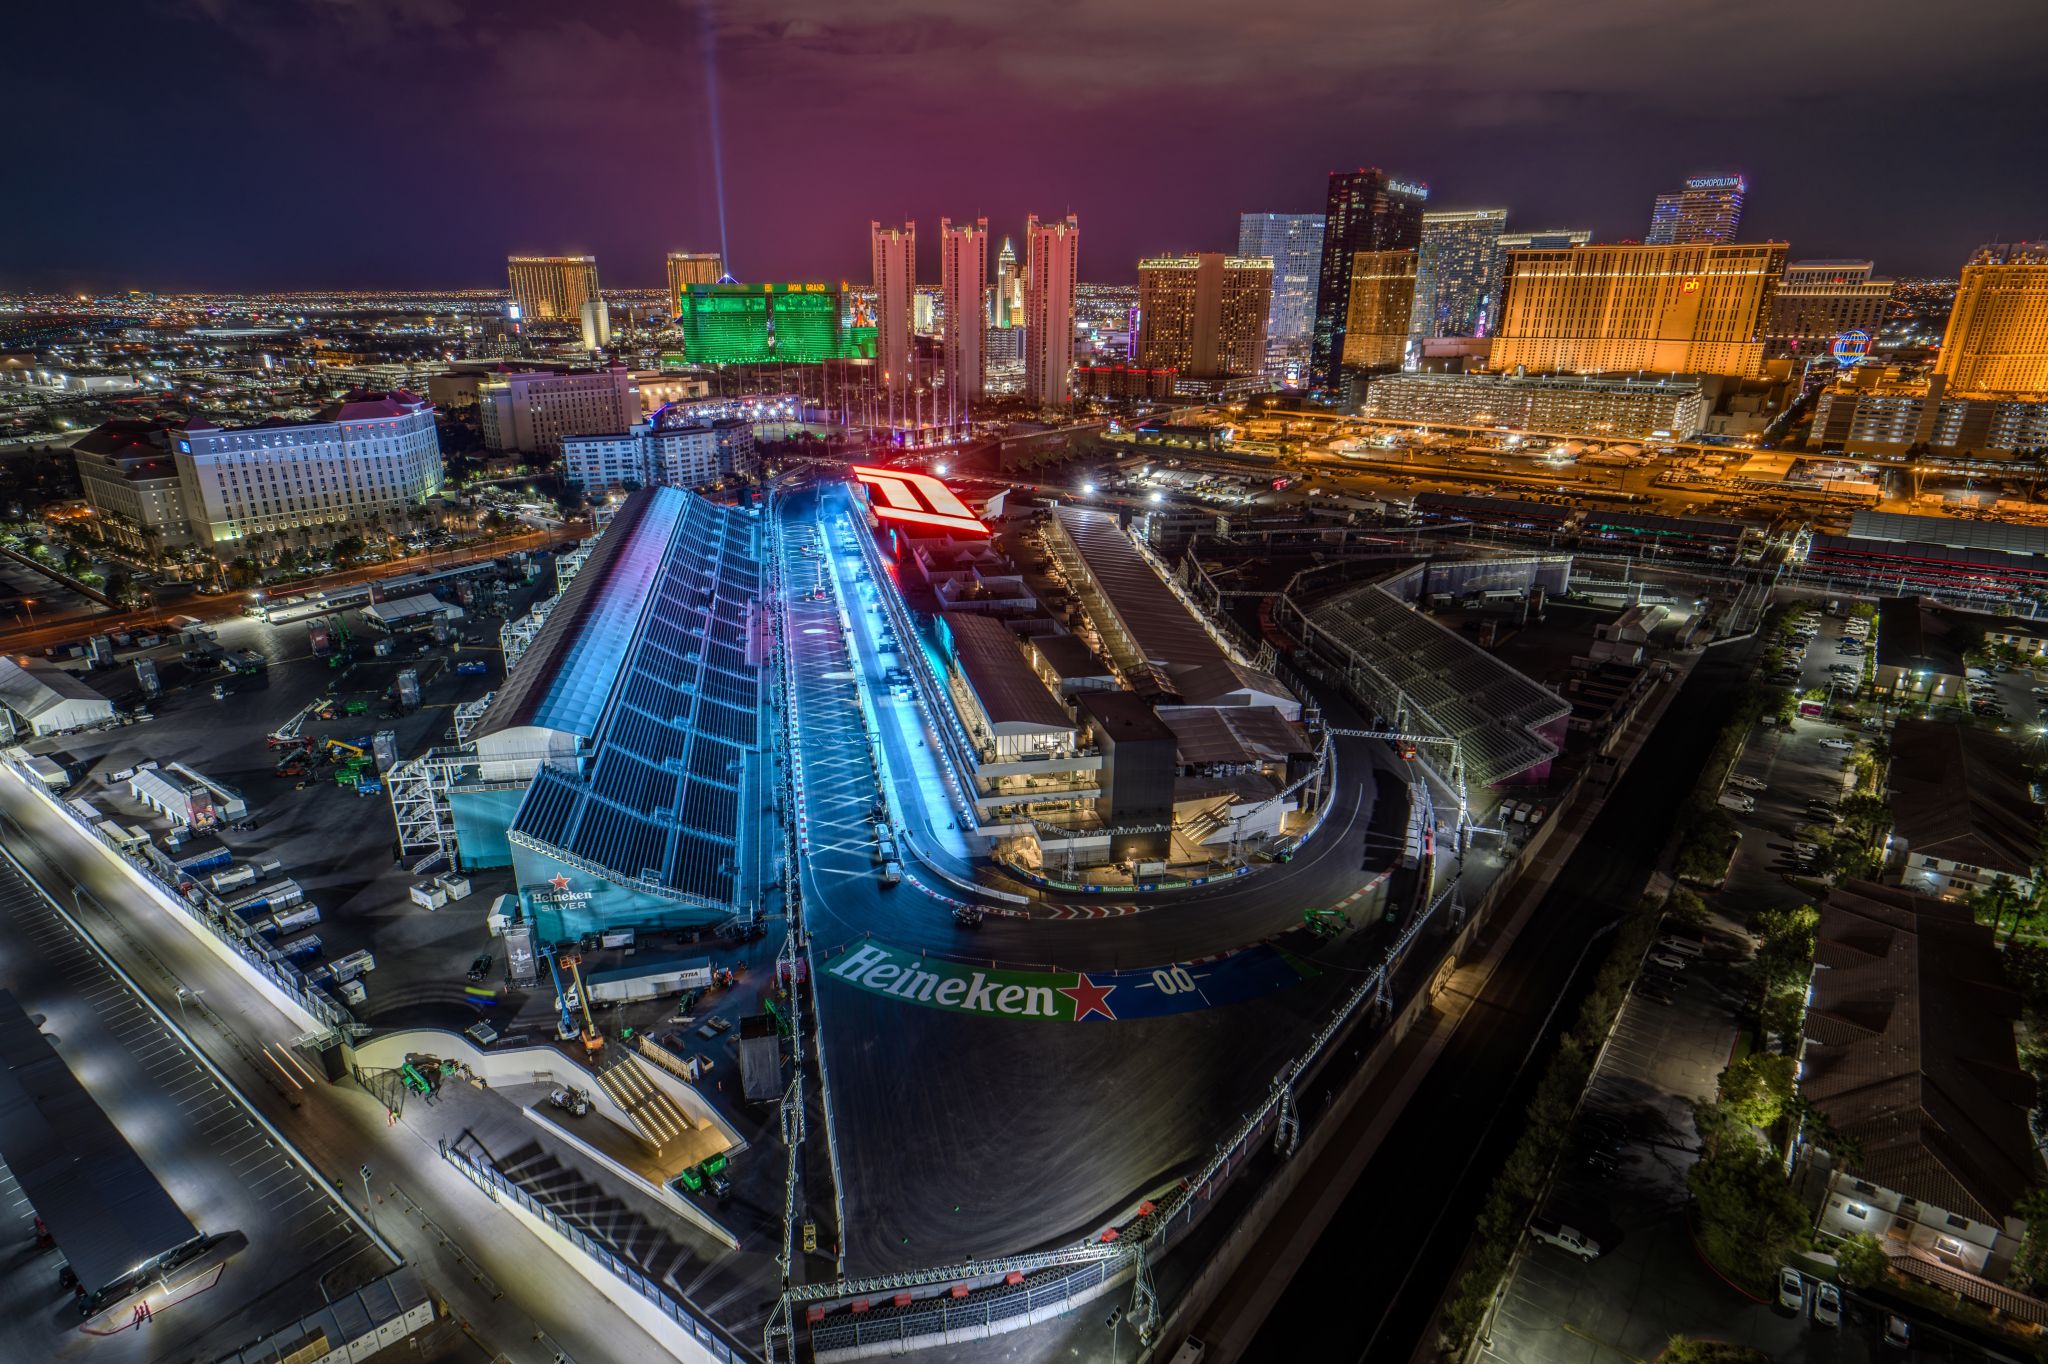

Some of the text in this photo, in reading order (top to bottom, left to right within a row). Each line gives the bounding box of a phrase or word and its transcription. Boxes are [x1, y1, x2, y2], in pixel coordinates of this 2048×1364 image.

[1691, 177, 1739, 188] COSMOPOLITAN
[788, 283, 825, 291] MGM GRAND
[1684, 278, 1699, 292] ph
[1048, 881, 1077, 890] Heineken
[1158, 882, 1186, 890] Heineken
[532, 889, 592, 903] Heineken
[541, 901, 586, 912] SILVER
[829, 944, 1195, 1016] Heineken 0.0
